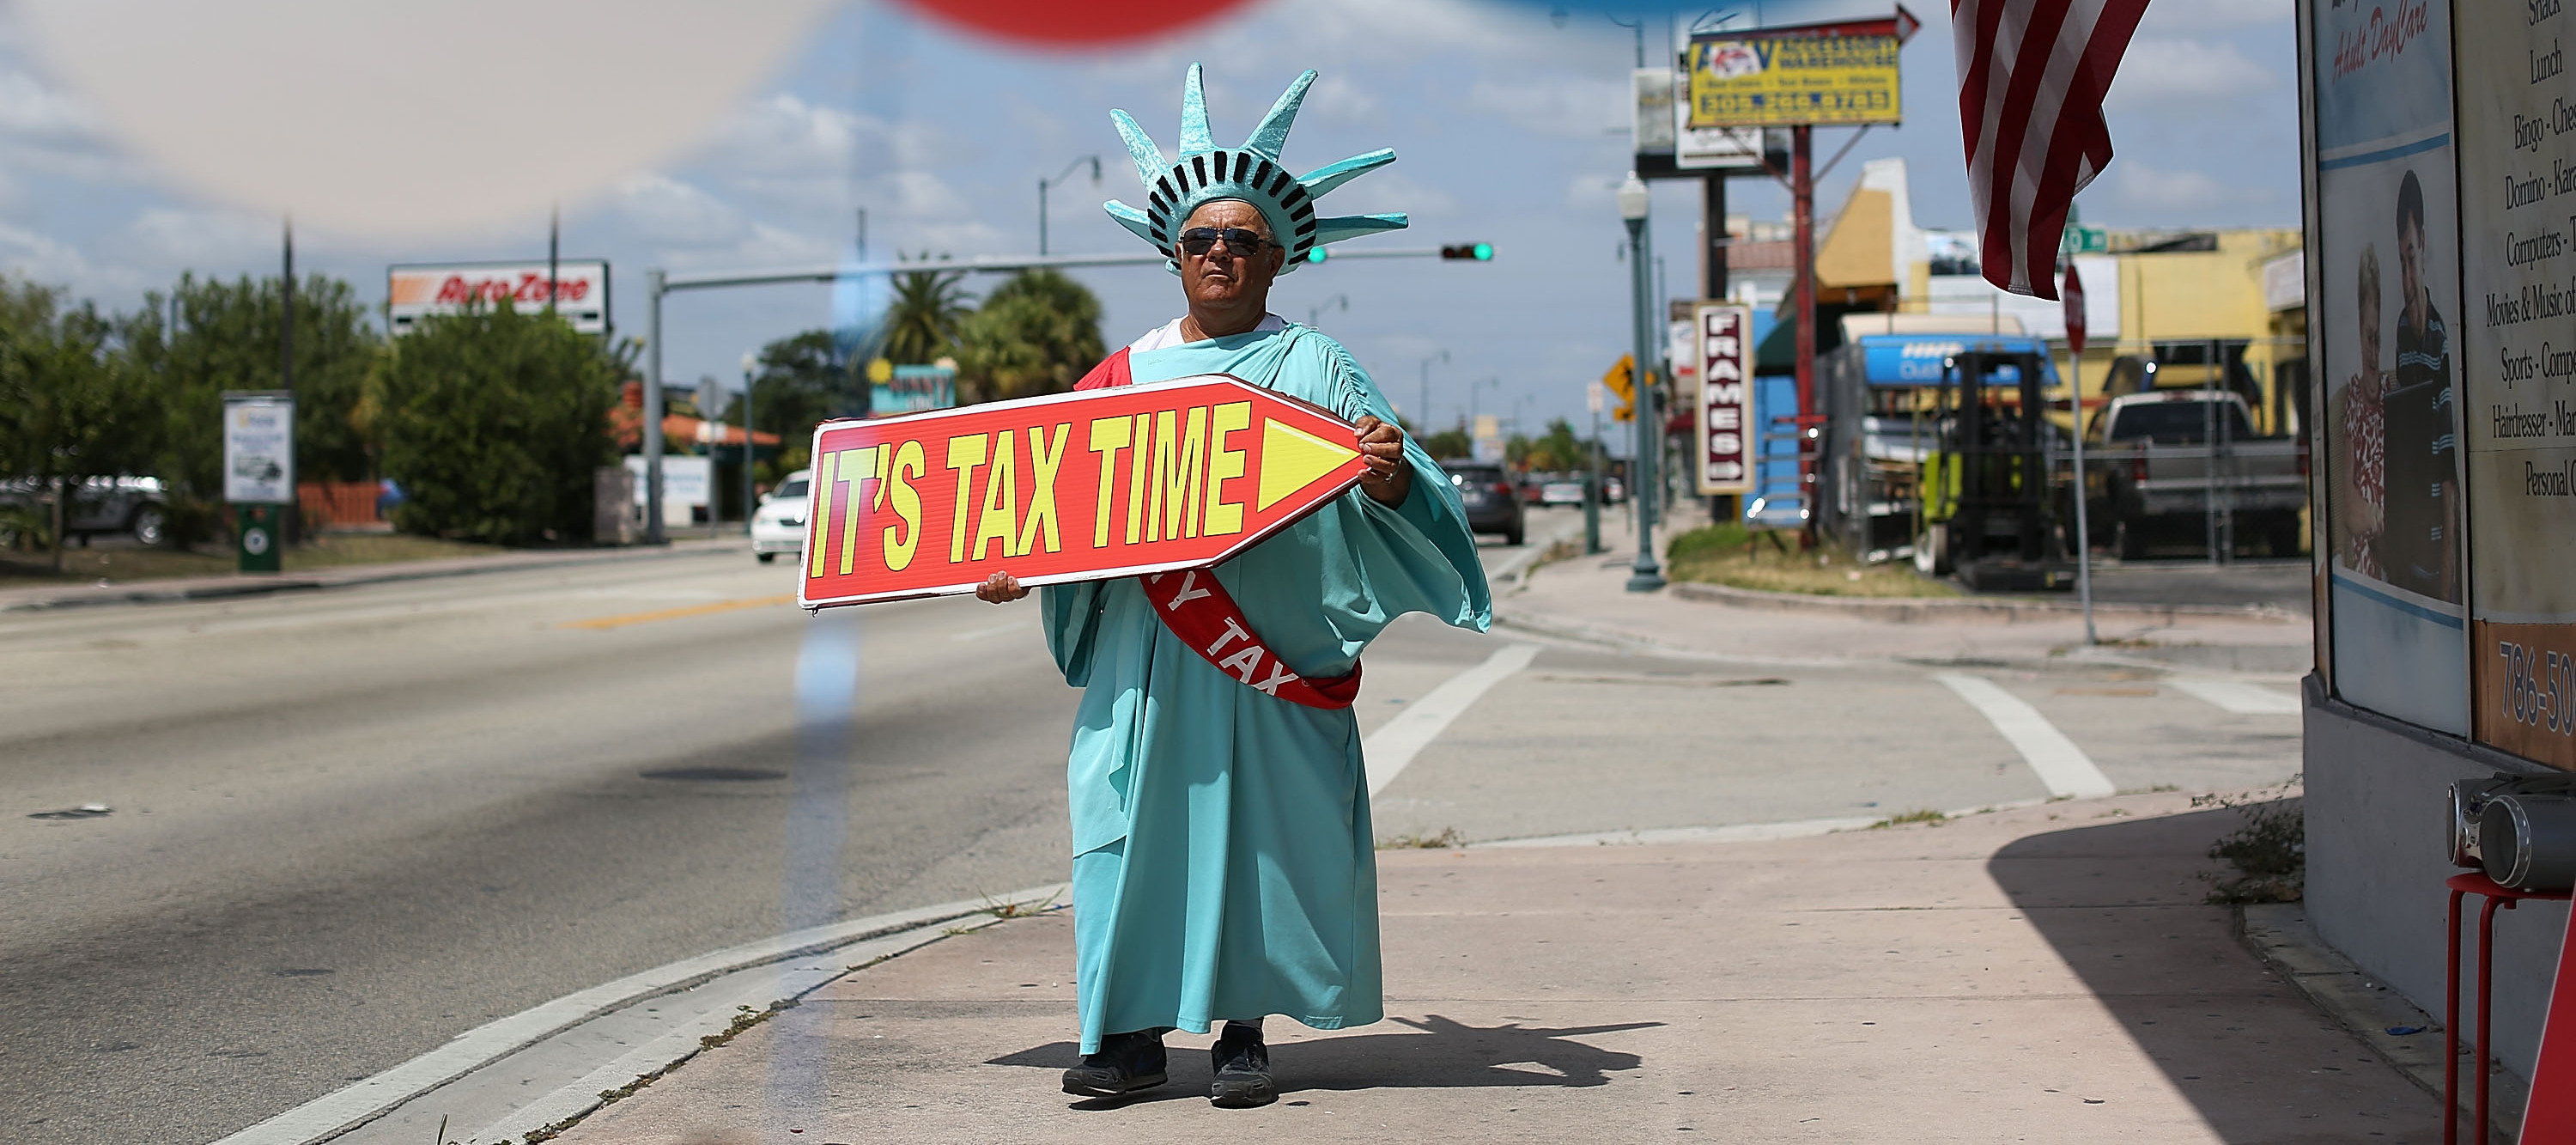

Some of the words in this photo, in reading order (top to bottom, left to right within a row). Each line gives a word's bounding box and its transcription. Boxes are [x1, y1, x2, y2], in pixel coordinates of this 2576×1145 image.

[2332, 25, 2366, 84] Adult
[2530, 37, 2563, 85] Lunch
[2514, 113, 2544, 153] Bingo
[2506, 170, 2545, 210] Domino
[2506, 227, 2561, 271] Computers
[2486, 293, 2519, 327] Movies
[2521, 285, 2531, 323] &
[2532, 283, 2563, 320] Music
[2565, 275, 2576, 315] of
[1708, 314, 1741, 455] FRAMES
[2501, 346, 2533, 389] Sports
[2493, 402, 2547, 438] Hairdresser
[810, 439, 927, 579] IT'S
[947, 422, 1072, 564] TAX
[1088, 399, 1253, 549] TIME
[2525, 459, 2568, 496] Personal
[1206, 616, 1299, 696] TAX
[2500, 641, 2576, 737] 786-50
